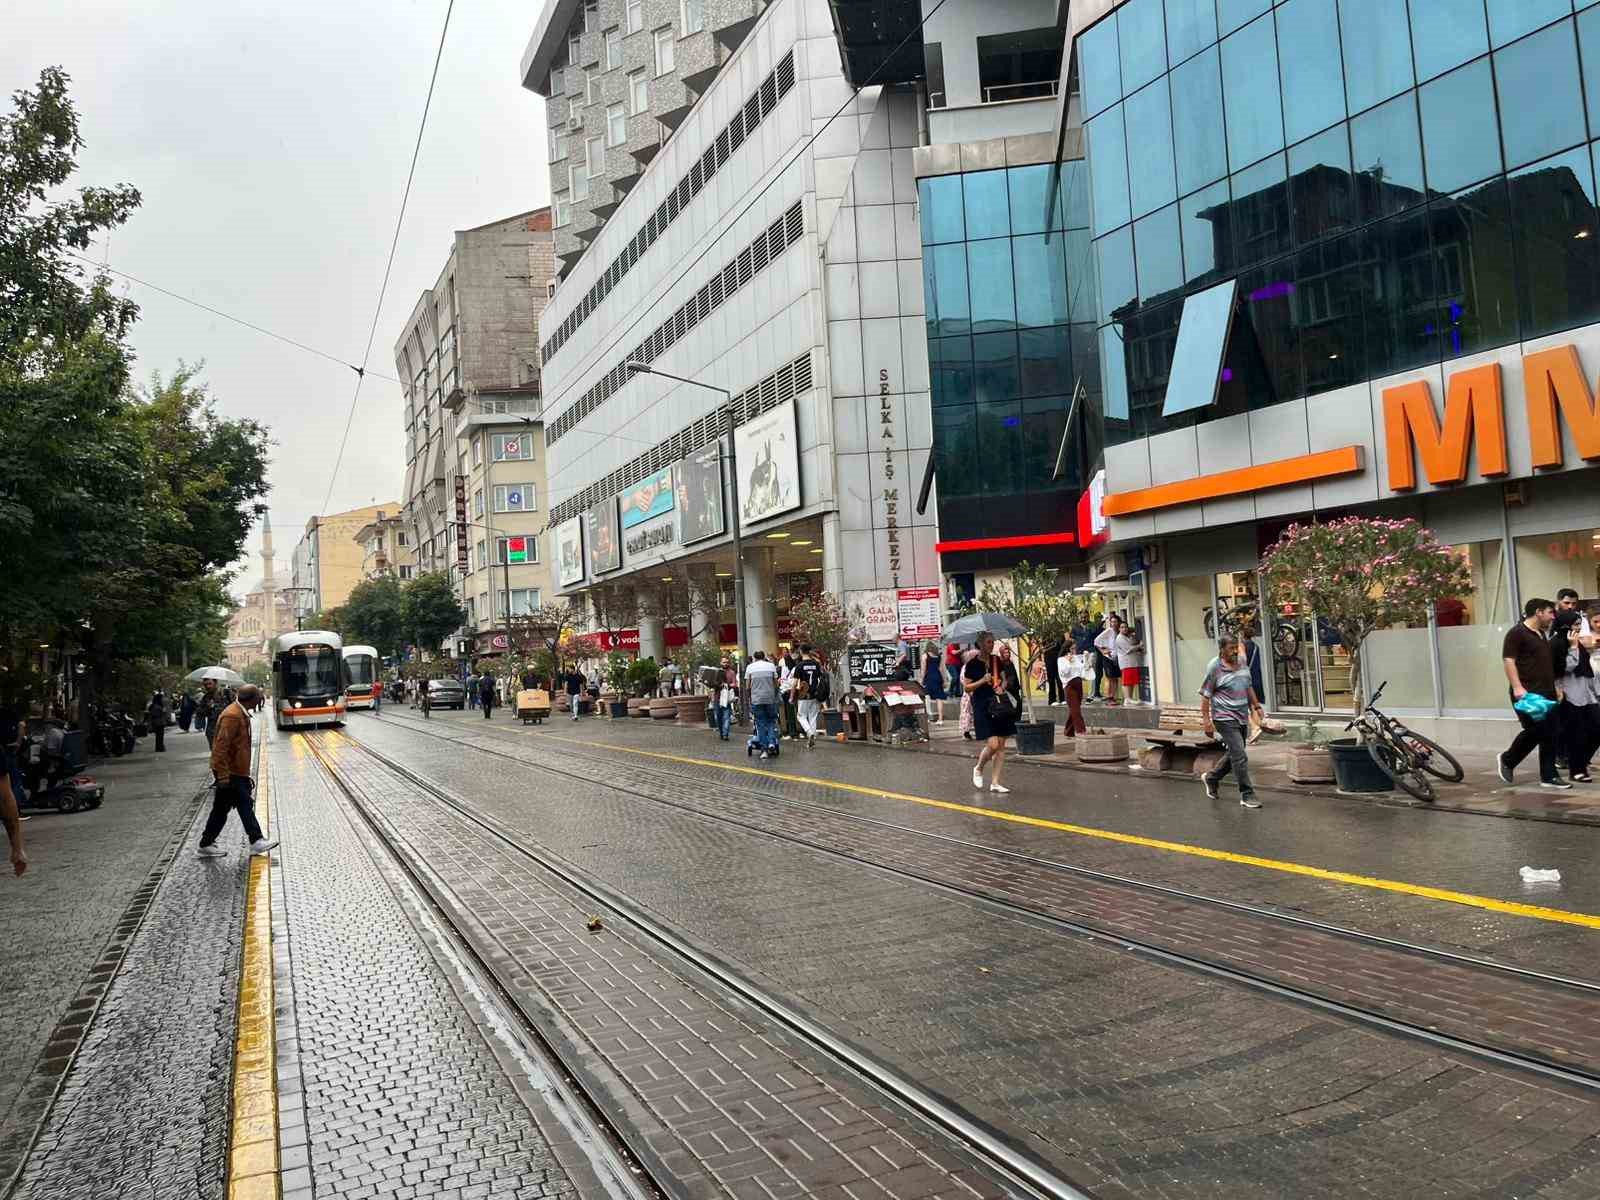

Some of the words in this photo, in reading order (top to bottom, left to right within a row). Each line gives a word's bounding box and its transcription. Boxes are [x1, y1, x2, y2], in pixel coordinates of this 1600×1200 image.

[880, 369, 893, 438] SELKA
[885, 447, 894, 480] İŞ
[884, 489, 901, 588] MERKEZİ
[866, 615, 897, 624] GRAND
[868, 607, 893, 615] GALA
[808, 671, 814, 685] 7
